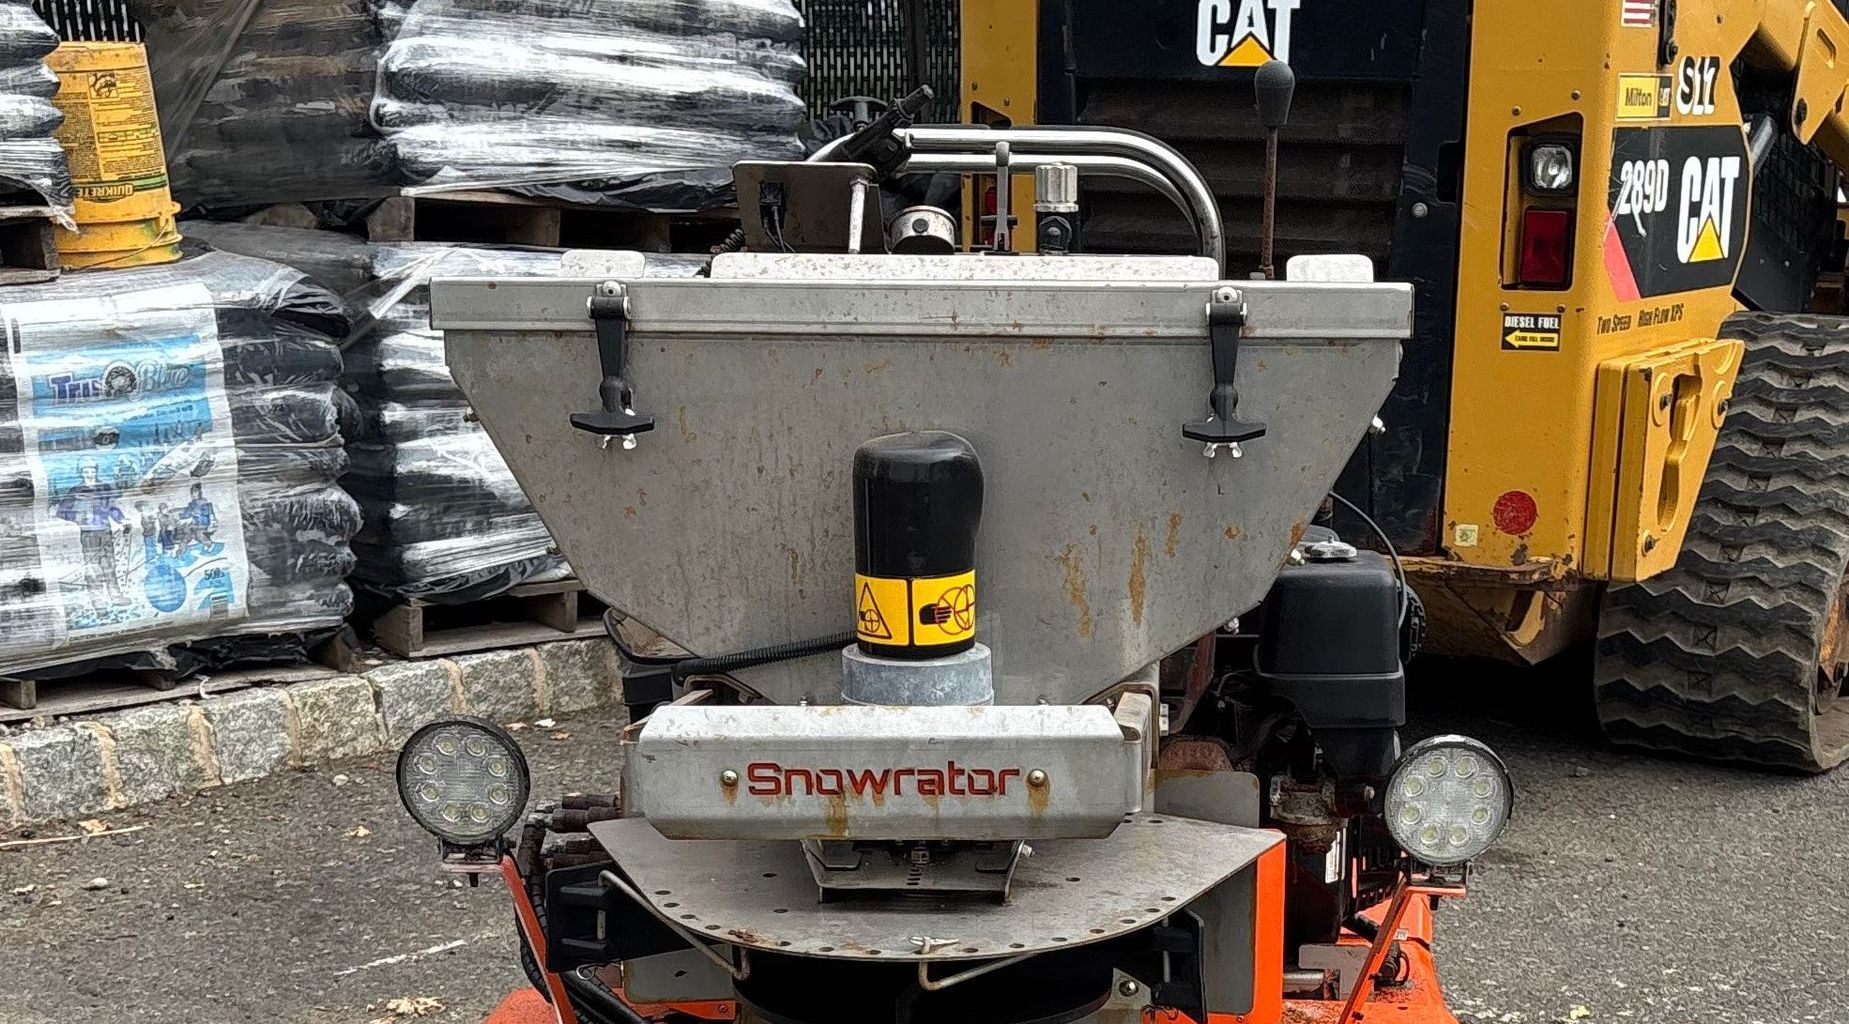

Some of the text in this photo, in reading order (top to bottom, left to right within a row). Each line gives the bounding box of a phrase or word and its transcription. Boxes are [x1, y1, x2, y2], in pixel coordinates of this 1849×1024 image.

[1196, 0, 1301, 67] CAT
[1625, 87, 1652, 106] Milton
[77, 184, 134, 198] QUIKRETE
[1618, 159, 1669, 215] 289D
[1677, 156, 1740, 263] CAT
[1504, 316, 1559, 329] DIESEL FUEL
[747, 761, 1020, 796] Snowrator
